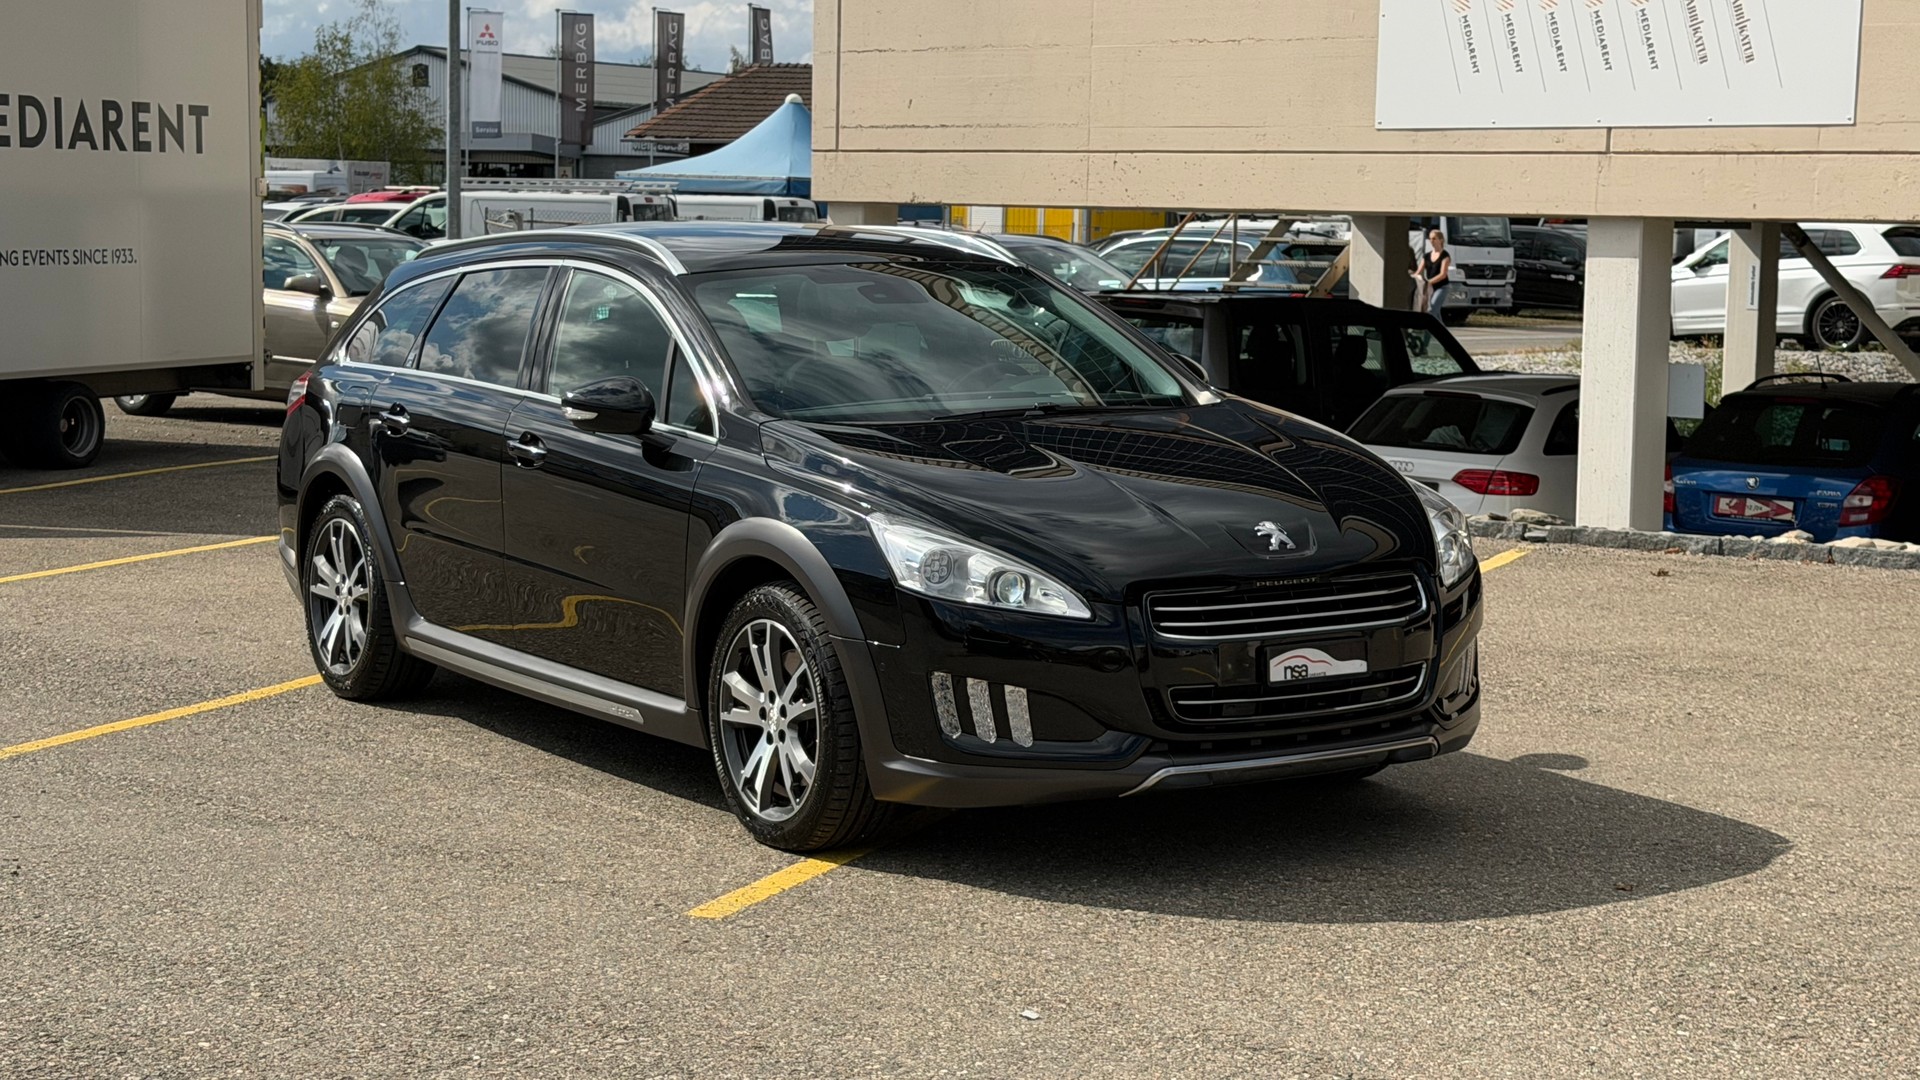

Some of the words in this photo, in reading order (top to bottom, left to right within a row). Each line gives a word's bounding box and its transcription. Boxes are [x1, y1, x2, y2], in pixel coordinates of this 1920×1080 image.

[575, 22, 587, 112] MERBAG
[1461, 14, 1480, 75] MEDIARENT
[1504, 13, 1523, 74] MEDIARENT
[1547, 11, 1568, 73] MEDIARENT
[1593, 9, 1613, 72] MEDIARENT
[1638, 7, 1659, 71] MEDIARENT
[475, 126, 499, 134] Service
[22, 249, 70, 266] EVENTS
[73, 249, 108, 265] SINCE
[111, 248, 138, 264] 1933.
[1257, 577, 1318, 587] PEUGEOT
[1283, 663, 1309, 681] nsa
